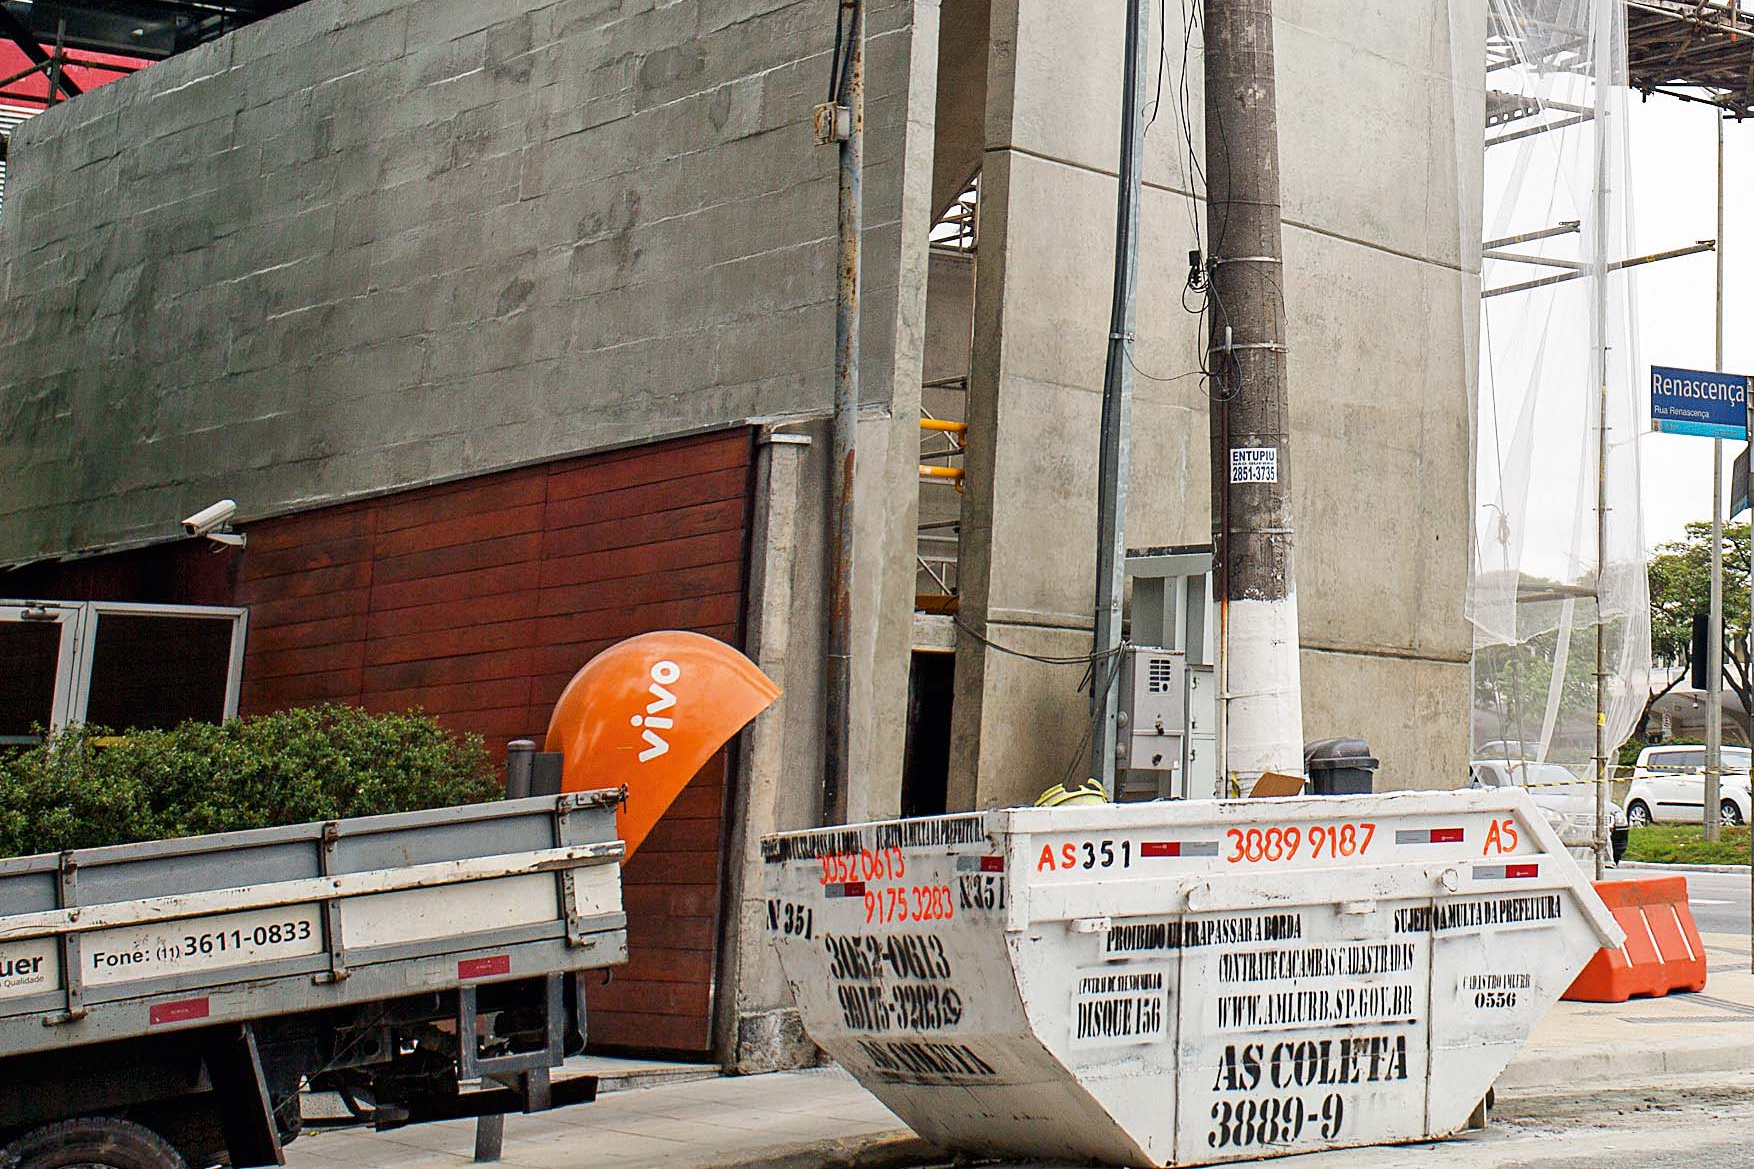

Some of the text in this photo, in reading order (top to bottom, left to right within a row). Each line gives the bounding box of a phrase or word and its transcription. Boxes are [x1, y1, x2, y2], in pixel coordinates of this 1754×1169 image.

[1653, 373, 1745, 407] Renascença
[1655, 405, 1710, 420] Rua Renascença
[1233, 450, 1275, 461] ENTUPIU
[638, 660, 680, 762] vivo
[1226, 823, 1376, 863] 3889 9187
[1483, 819, 1519, 856] AS
[816, 848, 859, 885] 3052
[861, 845, 905, 881] 0613
[865, 885, 954, 925] 9175 3283
[1394, 906, 1438, 934] SUJEITO
[1448, 901, 1484, 929] MULTA
[1484, 900, 1498, 925] DA
[1500, 894, 1561, 923] PREFEITURA
[93, 920, 311, 969] Fone: (11) 3611-0833
[1106, 922, 1164, 952] PROIBIDO
[1255, 917, 1262, 938] A
[1264, 913, 1301, 940] BORDA
[825, 933, 951, 979] 3052-0613
[1219, 950, 1277, 983] CONTRATE
[1338, 943, 1415, 977] CADASTRADAS
[5, 975, 45, 988] Qualidade
[1474, 992, 1516, 1008] 0556
[1077, 997, 1161, 1039] DISQUE 156
[1218, 985, 1413, 1028] WWW.AMLURB.SP.GOV.BR
[1212, 1035, 1408, 1091] AS COLETA
